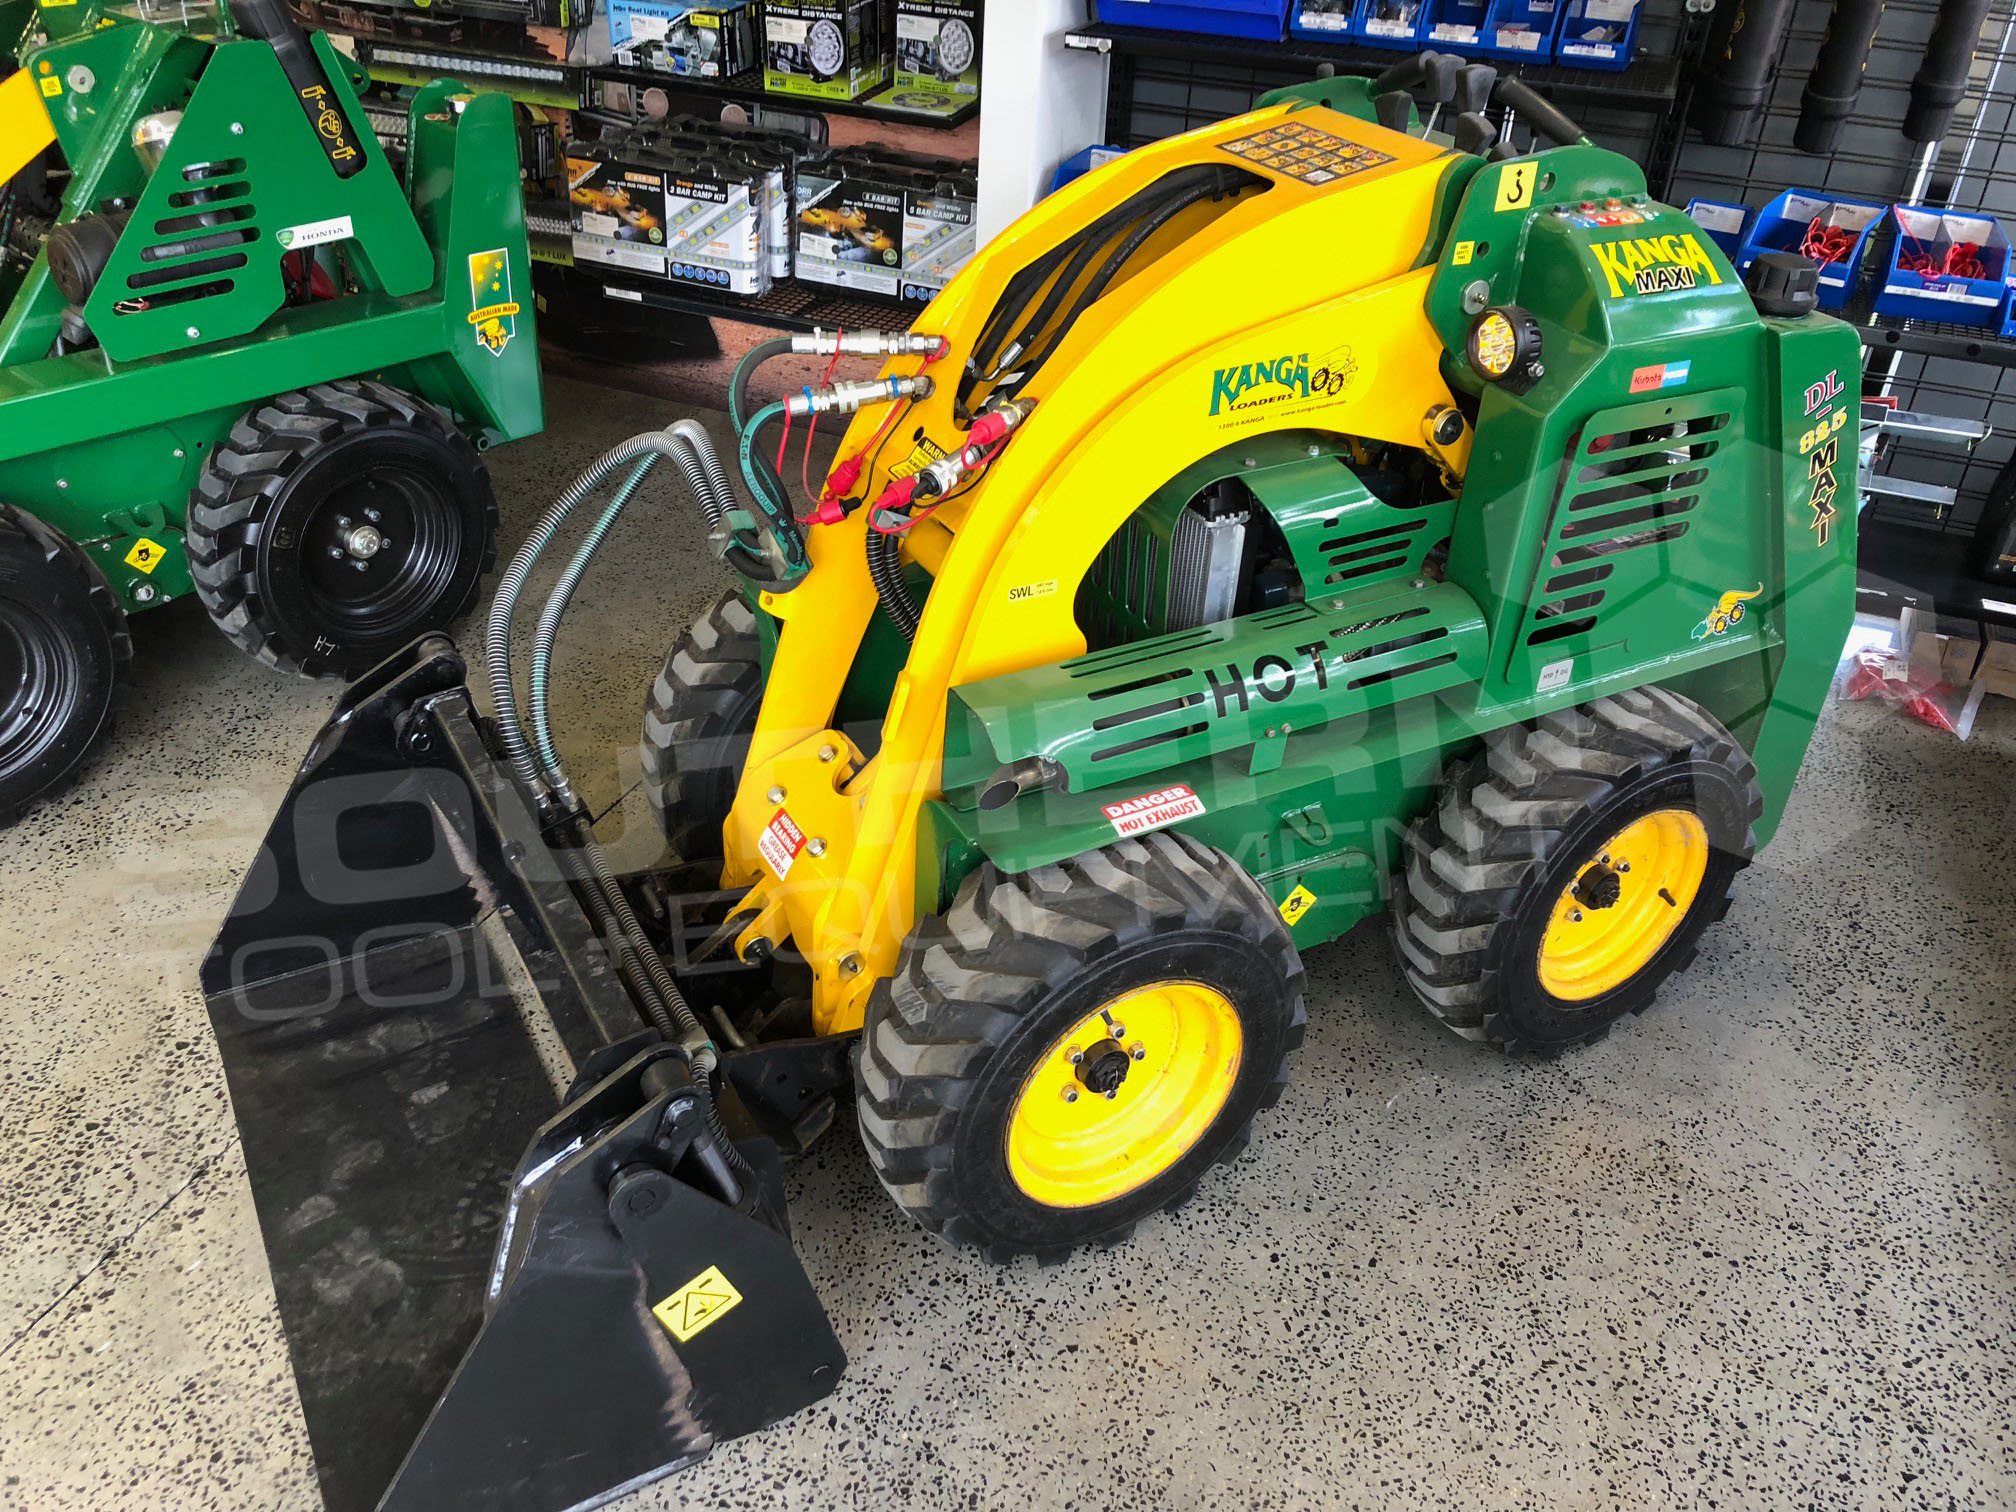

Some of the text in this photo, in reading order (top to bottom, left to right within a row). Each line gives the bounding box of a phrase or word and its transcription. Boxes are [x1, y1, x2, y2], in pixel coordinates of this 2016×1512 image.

[644, 7, 660, 16] Light
[765, 5, 843, 20] XTREME DISTANCE
[897, 1, 933, 13] XTREME
[934, 6, 975, 18] DISTANCE
[676, 187, 691, 196] BAR
[692, 189, 713, 199] CAMP
[714, 193, 726, 202] KIT
[916, 207, 931, 217] BAR
[933, 210, 955, 220] CAMP
[955, 214, 969, 223] KIT
[302, 227, 344, 241] HONDA
[1588, 233, 1723, 299] KANGA
[1634, 265, 1696, 295] MAXI
[470, 304, 518, 322] AUSTRALIAN MADE
[1208, 353, 1311, 417] KANGA
[1635, 373, 1662, 385] Kubota
[1804, 369, 1846, 417] DL
[1229, 392, 1294, 412] LOADERS
[1240, 416, 1265, 425] KANGA
[1799, 405, 1848, 455] 825
[1807, 436, 1838, 548] MAXI
[1009, 585, 1034, 600] SWL
[1203, 640, 1329, 718] HOT
[1105, 787, 1190, 818] DANGER
[1119, 800, 1199, 833] HOT EXHAUST
[771, 820, 797, 854] BEARING
[779, 813, 803, 843] HIDDEN
[760, 840, 786, 876] REGULARLY
[768, 836, 787, 862] GREASE
